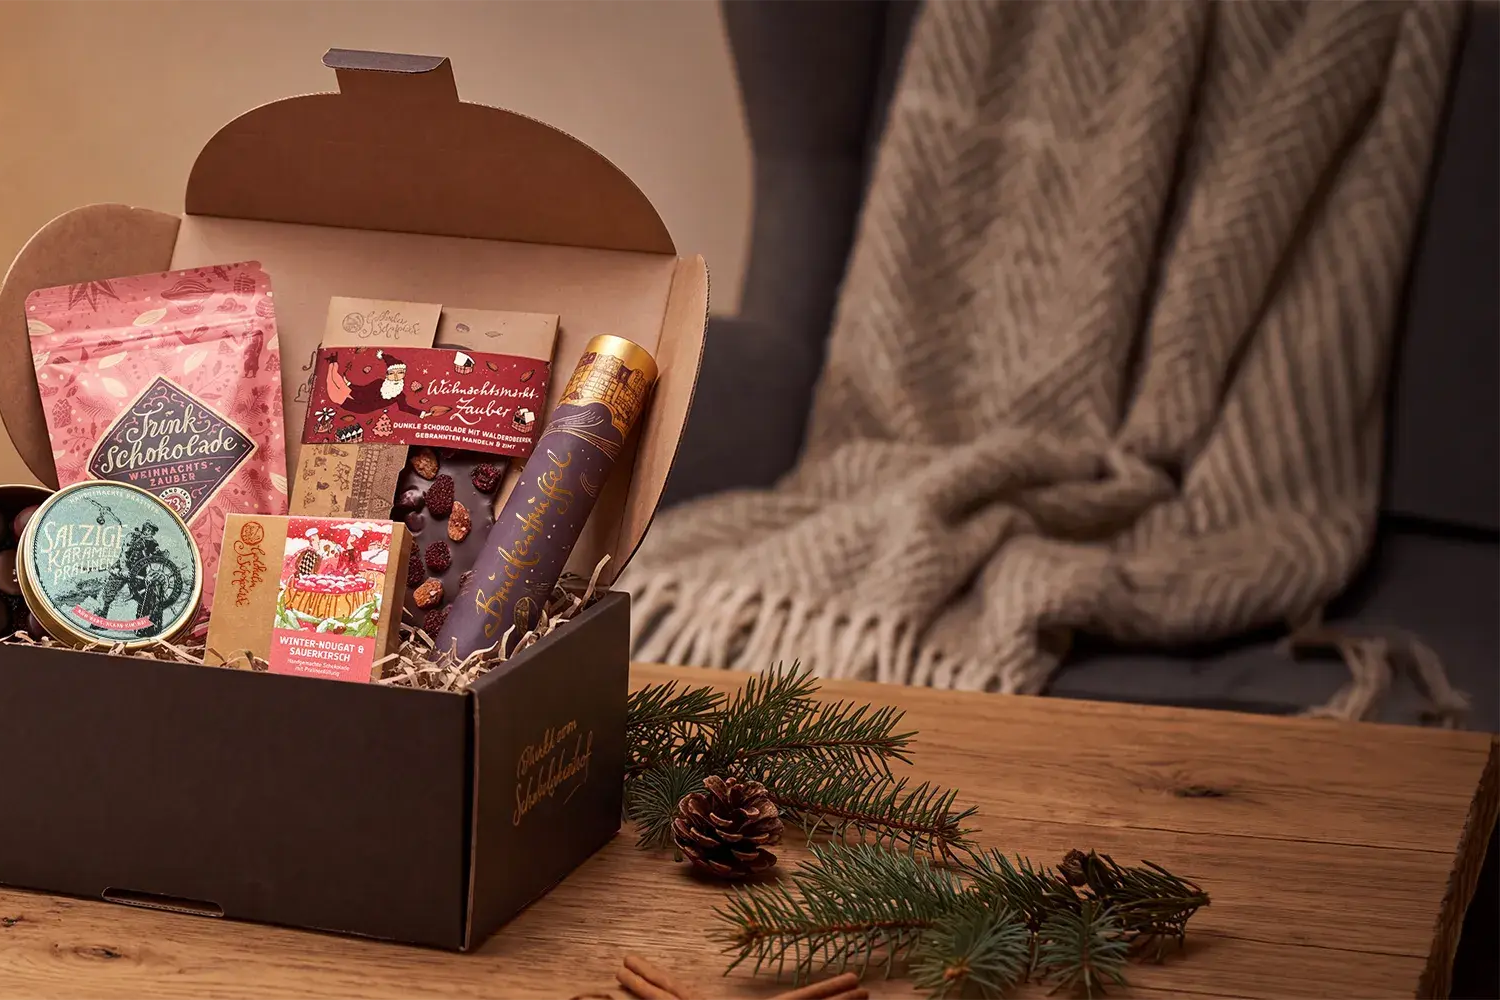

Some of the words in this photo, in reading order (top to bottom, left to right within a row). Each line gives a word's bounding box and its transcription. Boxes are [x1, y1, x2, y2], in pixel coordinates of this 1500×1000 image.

[450, 397, 512, 425] Zauber
[126, 402, 211, 443] Trink
[393, 422, 421, 430] DUNKLE
[423, 423, 467, 434] SCHOKOLADE
[467, 427, 481, 436] MIT
[415, 432, 461, 442] GEBRANNTEN
[462, 437, 494, 447] MANDELN
[101, 426, 238, 474] Schokolade
[150, 473, 196, 487] ZAUBER
[279, 636, 355, 652] WINTER-NOUGAT
[357, 645, 365, 654] &
[289, 647, 351, 662] SAUERKIRSCH
